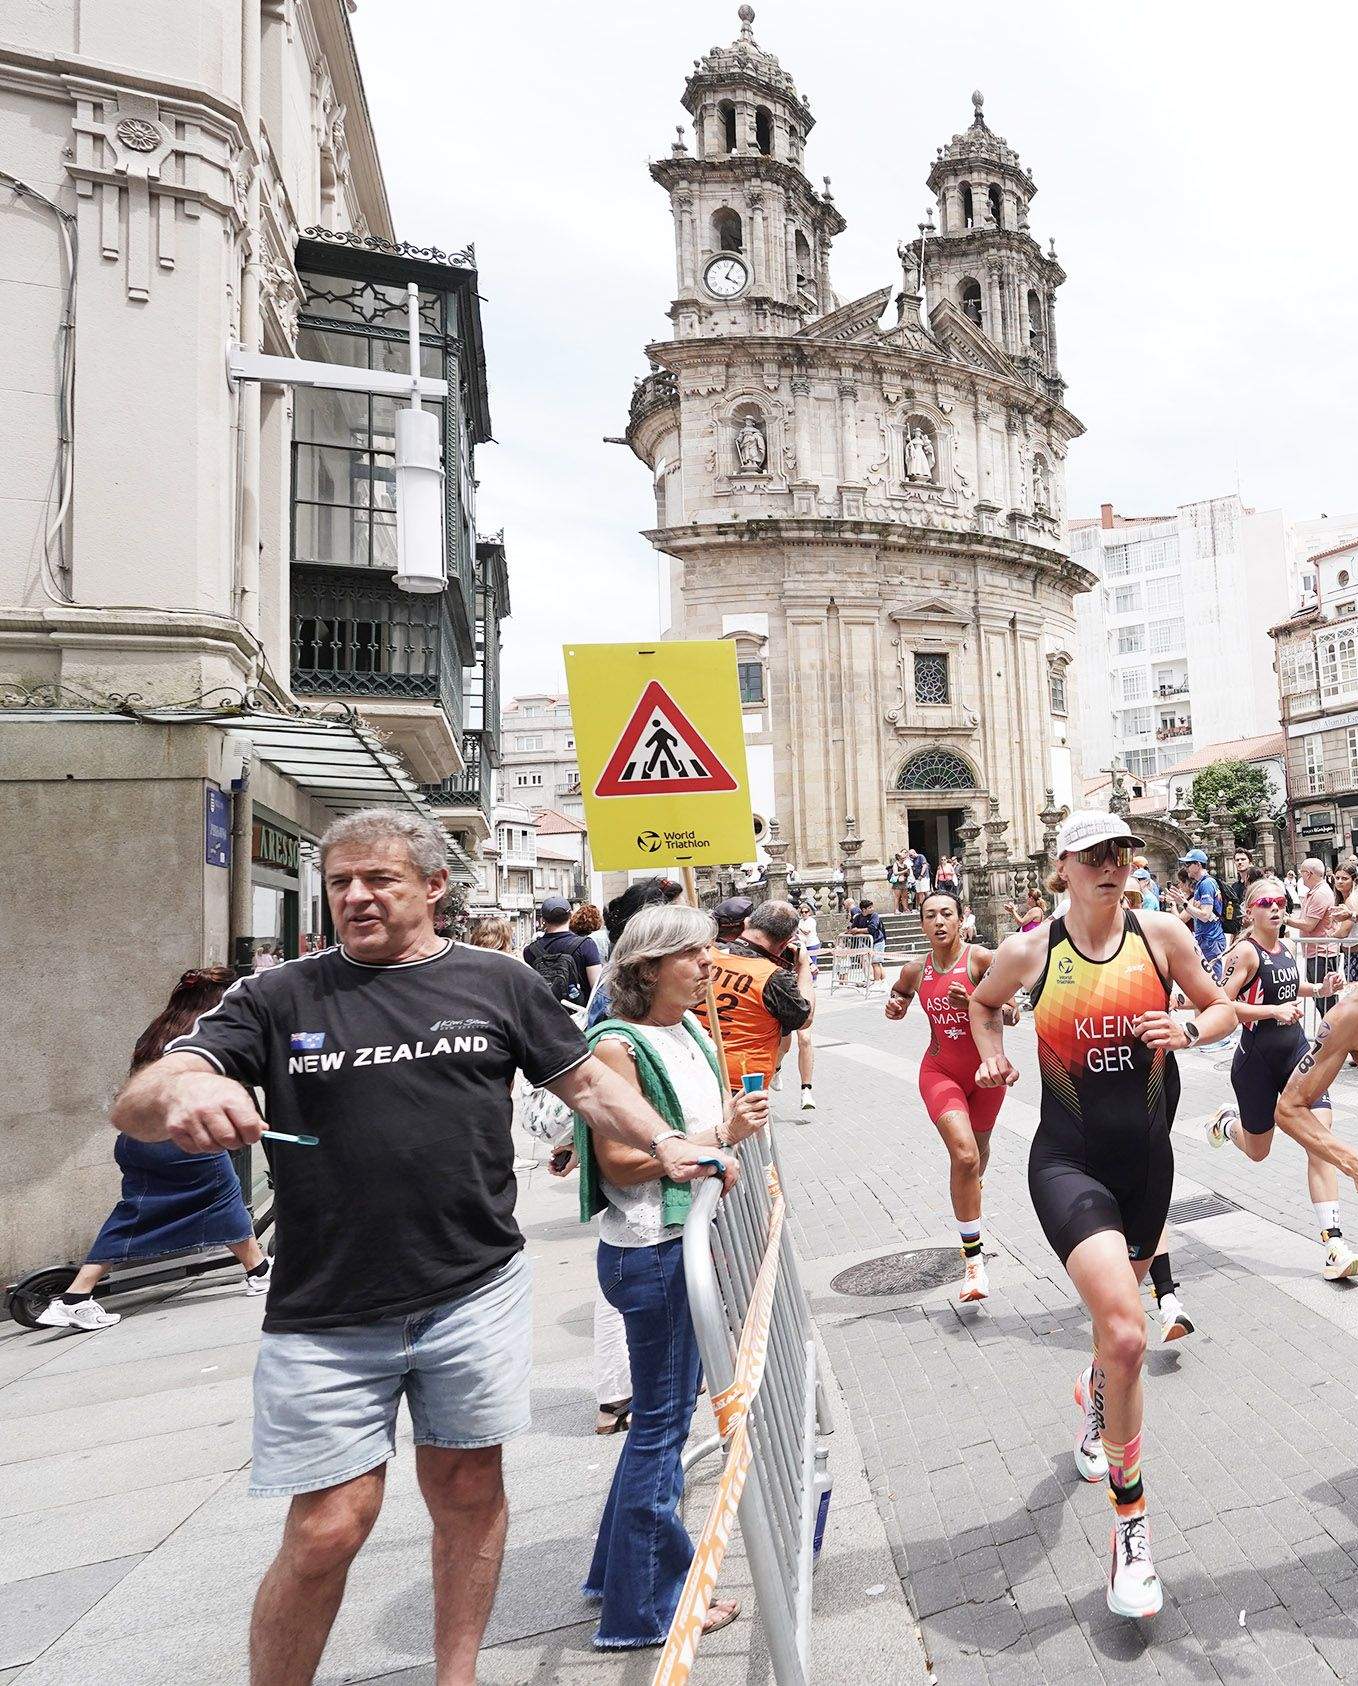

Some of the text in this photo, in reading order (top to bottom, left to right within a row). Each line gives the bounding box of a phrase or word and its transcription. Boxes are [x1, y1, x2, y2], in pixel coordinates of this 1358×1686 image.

[664, 831, 696, 840] World
[666, 840, 710, 849] Triathlon
[1271, 966, 1298, 983] LOUW
[1278, 983, 1297, 1000] GBR
[926, 996, 959, 1012] ASS
[931, 1011, 970, 1024] MAR
[1074, 1013, 1139, 1040] KLEIN
[288, 1036, 489, 1075] NEW ZEALAND
[1086, 1045, 1135, 1073] GER
[1298, 1040, 1323, 1074] 78
